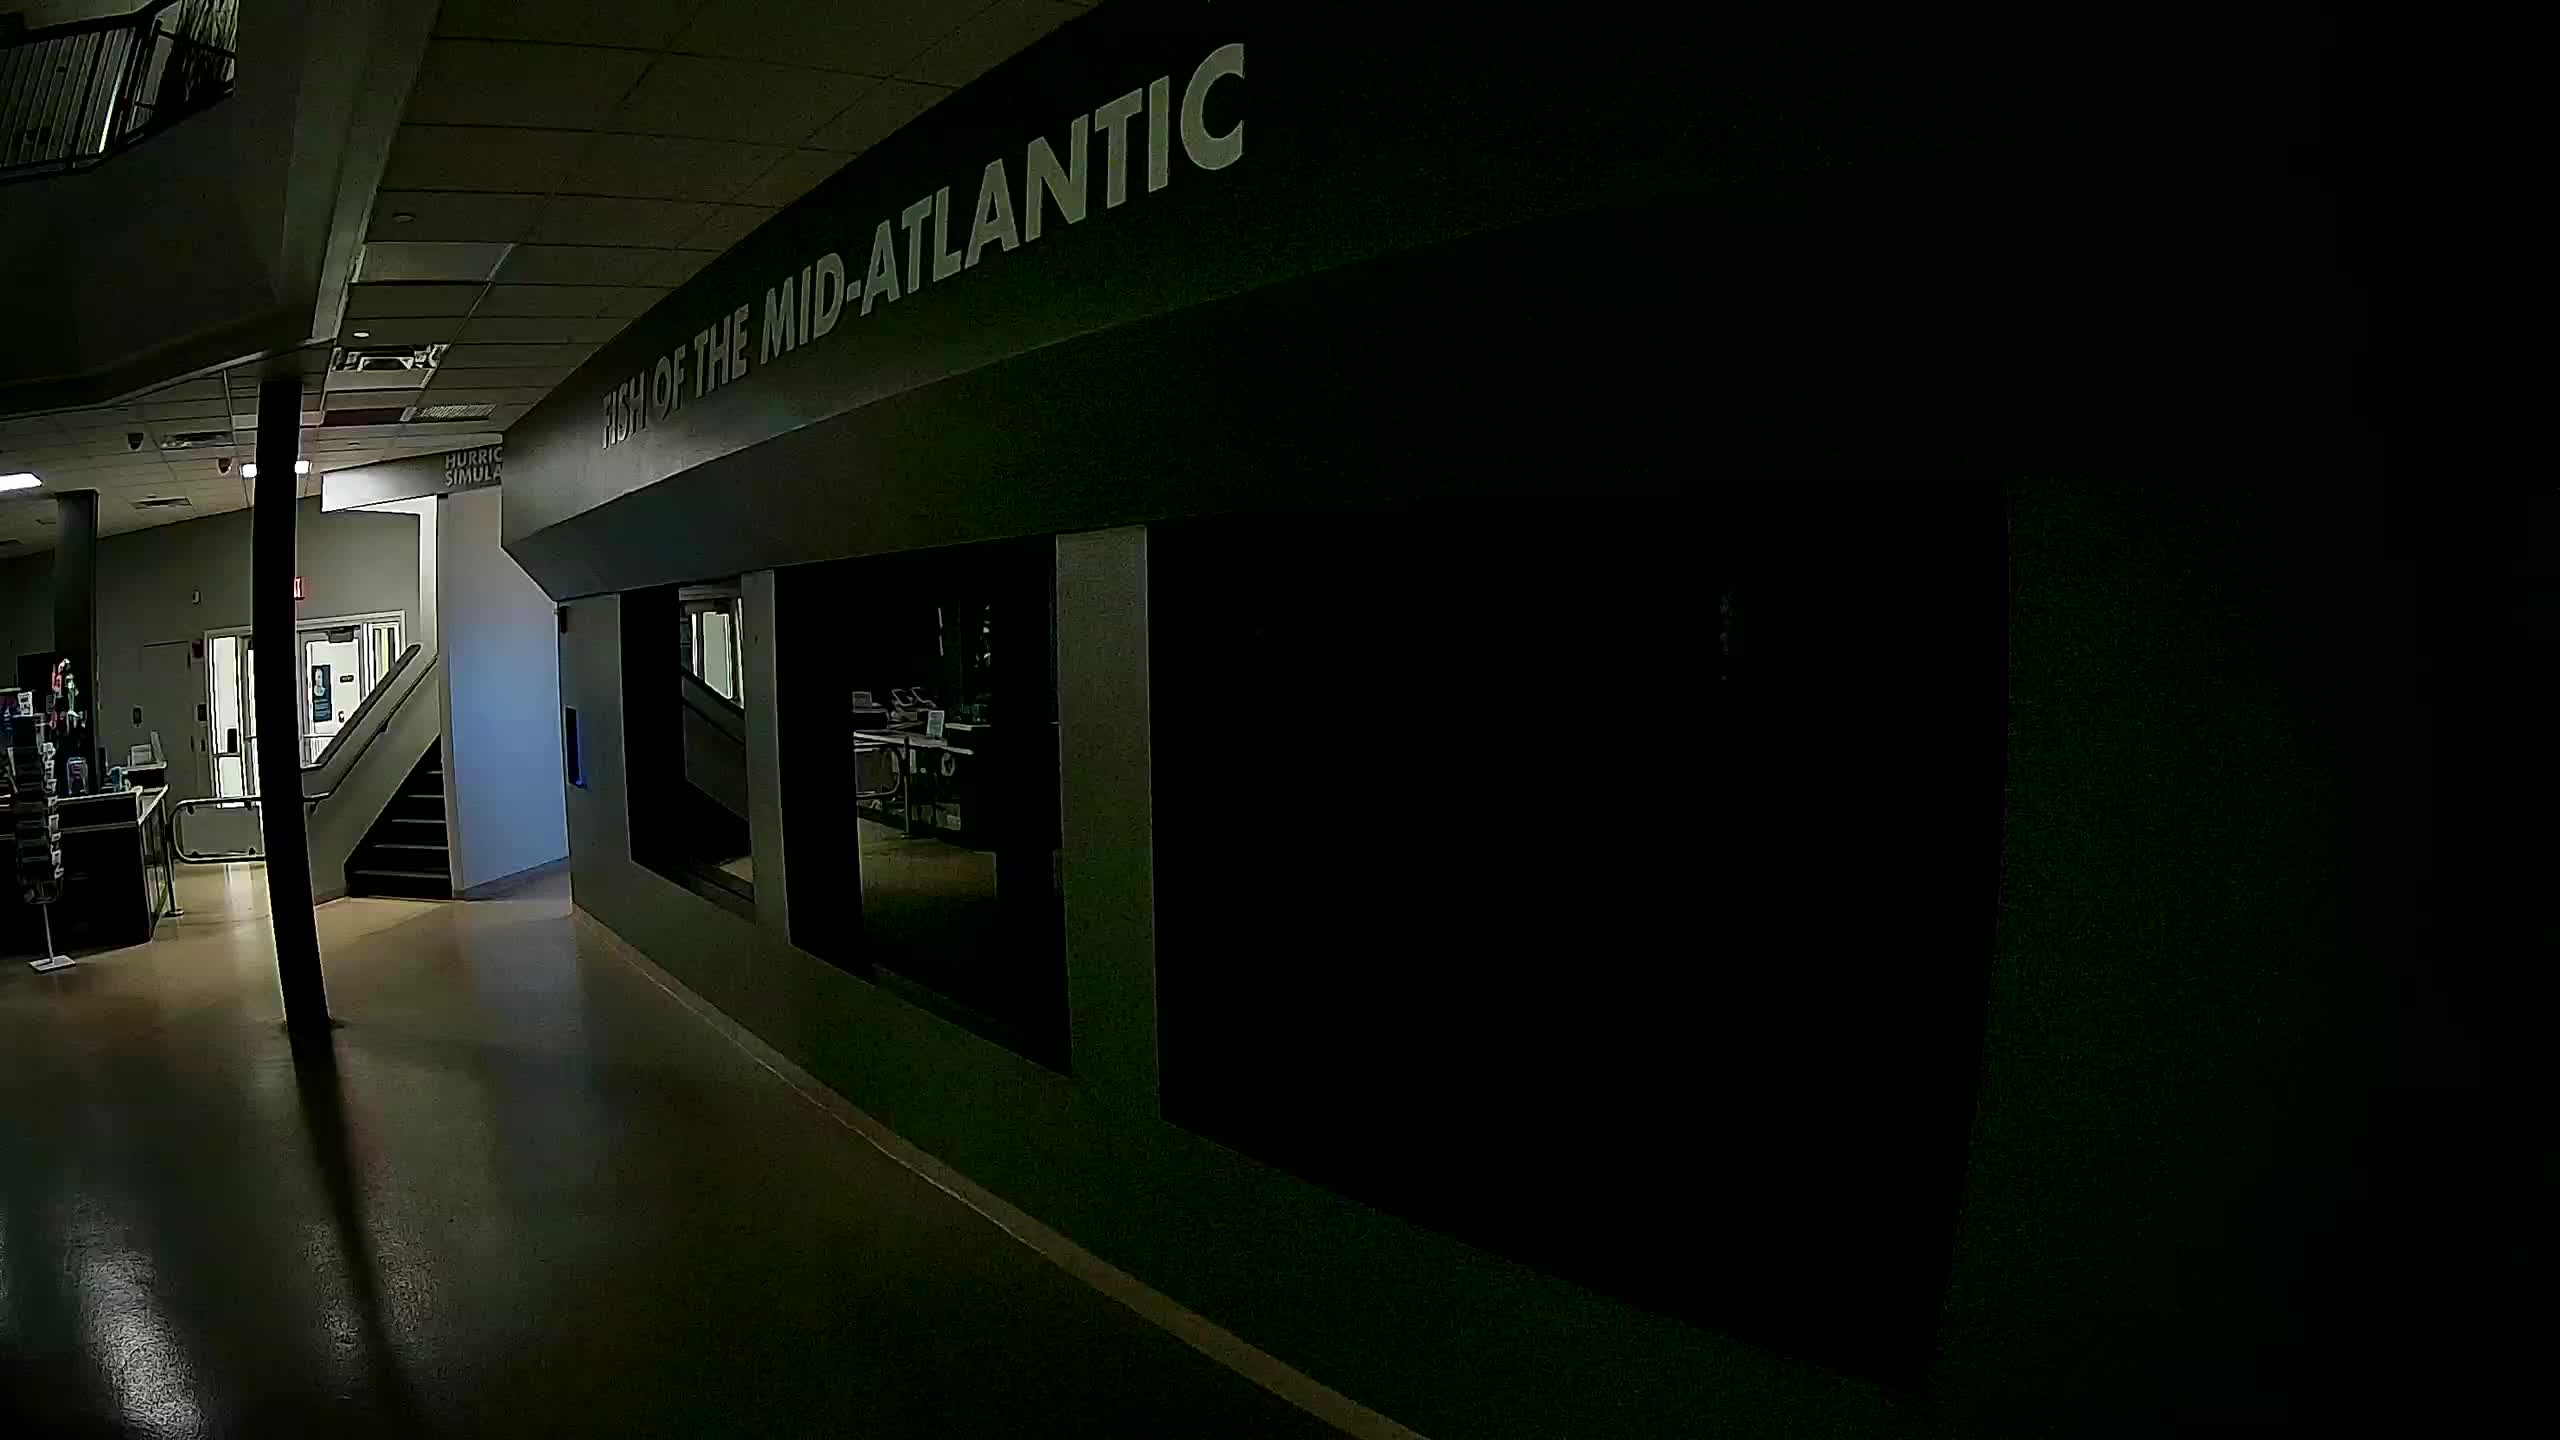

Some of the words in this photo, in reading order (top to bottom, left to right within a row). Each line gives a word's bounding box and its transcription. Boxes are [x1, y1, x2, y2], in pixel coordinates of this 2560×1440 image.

[602, 368, 648, 450] FISH
[651, 343, 687, 418] OF
[694, 303, 750, 399] THE
[760, 43, 1245, 365] MID-ATLANTIC
